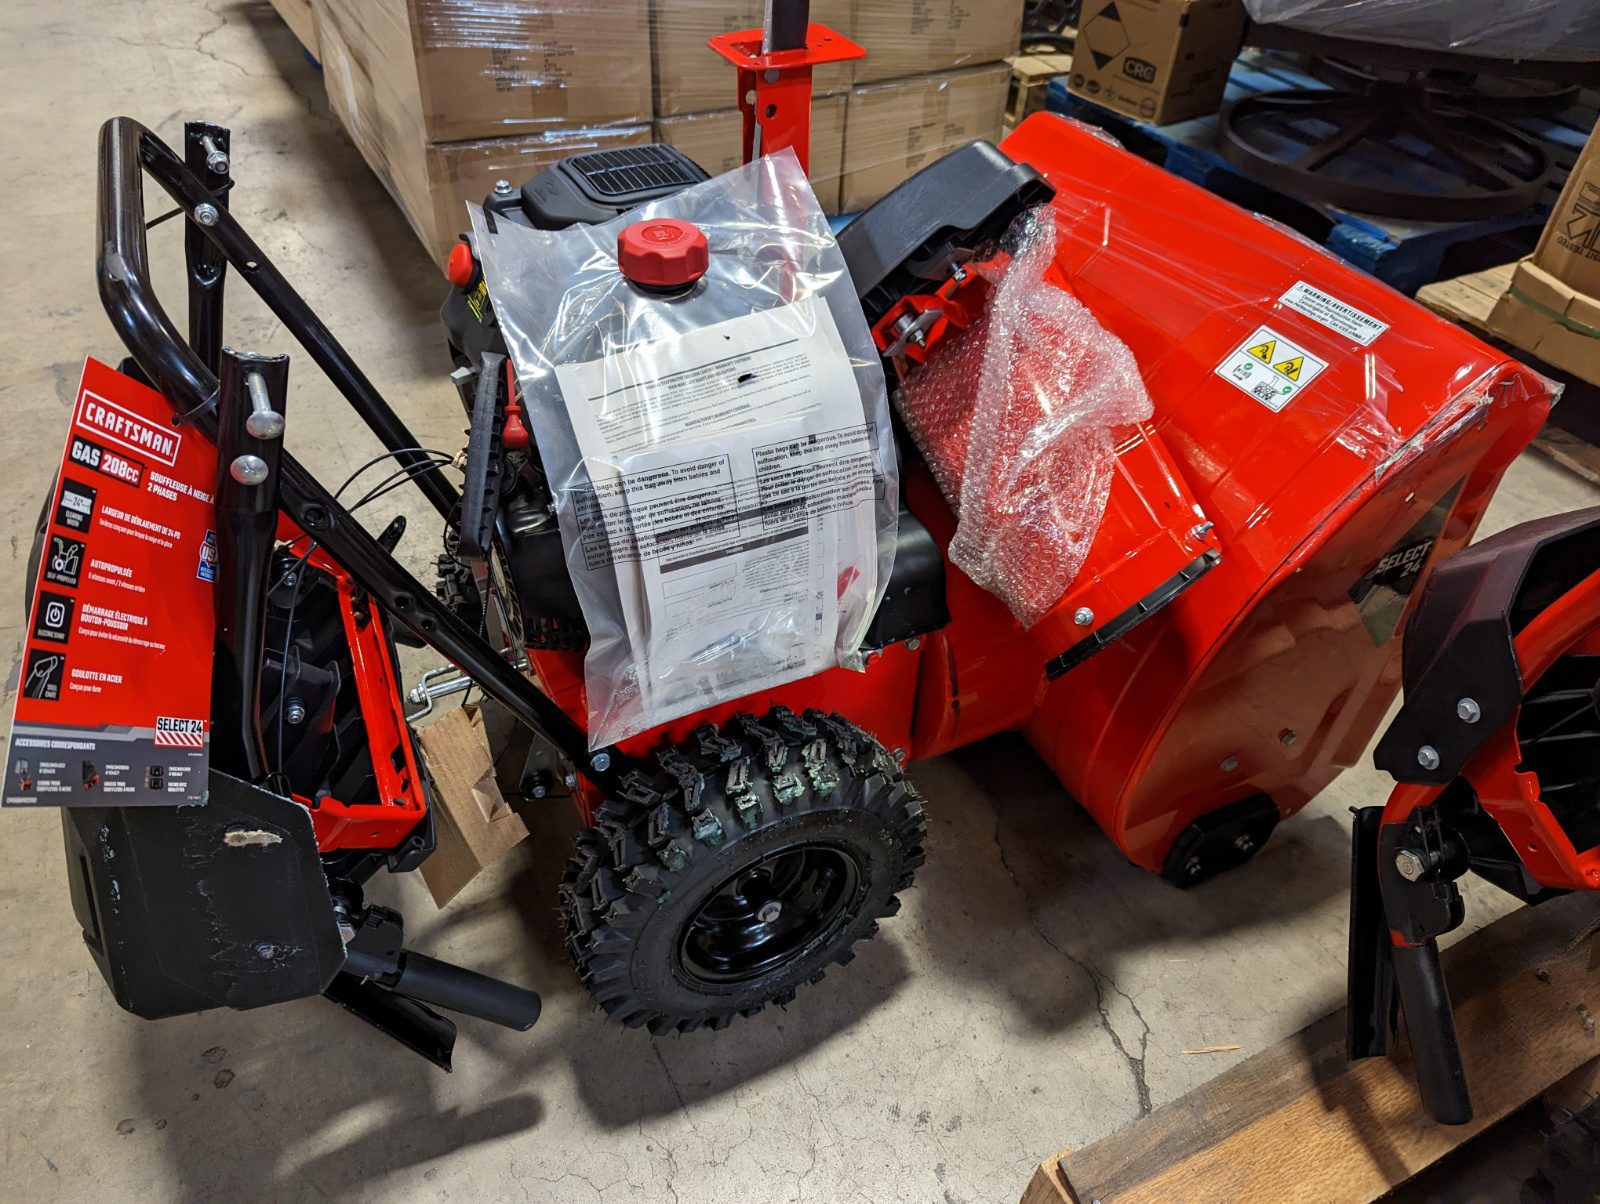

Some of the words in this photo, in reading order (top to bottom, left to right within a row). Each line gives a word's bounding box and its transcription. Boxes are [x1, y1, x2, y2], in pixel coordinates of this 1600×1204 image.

[1124, 60, 1154, 80] CRC
[1556, 235, 1583, 256] TESTED
[1303, 287, 1382, 331] WARNING/AVERTISSEMENT
[85, 402, 173, 457] CRAFTSMAN
[72, 441, 101, 467] GAS
[755, 447, 774, 456] Plastic
[756, 452, 788, 464] suffocation,
[812, 444, 823, 452] bag
[596, 482, 613, 491] bags
[636, 471, 670, 483] dangerous.
[679, 465, 696, 473] avoid
[696, 461, 717, 471] danger
[758, 462, 782, 471] children.
[147, 482, 154, 492] 2
[153, 484, 178, 502] PHASES
[150, 471, 188, 494] SOUFFLEUSE
[575, 490, 614, 503] suffocation,
[614, 487, 630, 496] keep
[631, 484, 643, 492] this
[643, 481, 657, 489] bag
[657, 478, 672, 486] away
[688, 470, 708, 479] babies
[576, 501, 604, 511] children.
[618, 504, 648, 516] plastique
[649, 499, 674, 510] peuvent
[737, 500, 768, 510] CALIFORNIA
[101, 505, 124, 520] LARGEUR
[161, 526, 169, 536] DE
[625, 513, 647, 523] danger
[582, 532, 595, 540] pas
[585, 544, 598, 552] Las
[598, 540, 620, 549] bolsas
[606, 545, 628, 556] peligro
[588, 557, 605, 566] fuera
[617, 550, 641, 561] alcance
[1376, 541, 1433, 574] SELECT
[90, 559, 133, 578] AUTOPROPULSÉE
[1400, 558, 1423, 578] 24
[81, 613, 129, 631] BOUTON-POUSSOIR
[82, 603, 115, 620] DÉMARRAGE
[114, 610, 145, 626] ÉLECTRIQUE
[71, 668, 99, 681] GOULOTTE
[98, 673, 107, 681] EN
[106, 674, 123, 684] ACIER
[157, 717, 189, 733] SELECT
[191, 720, 202, 734] 24
